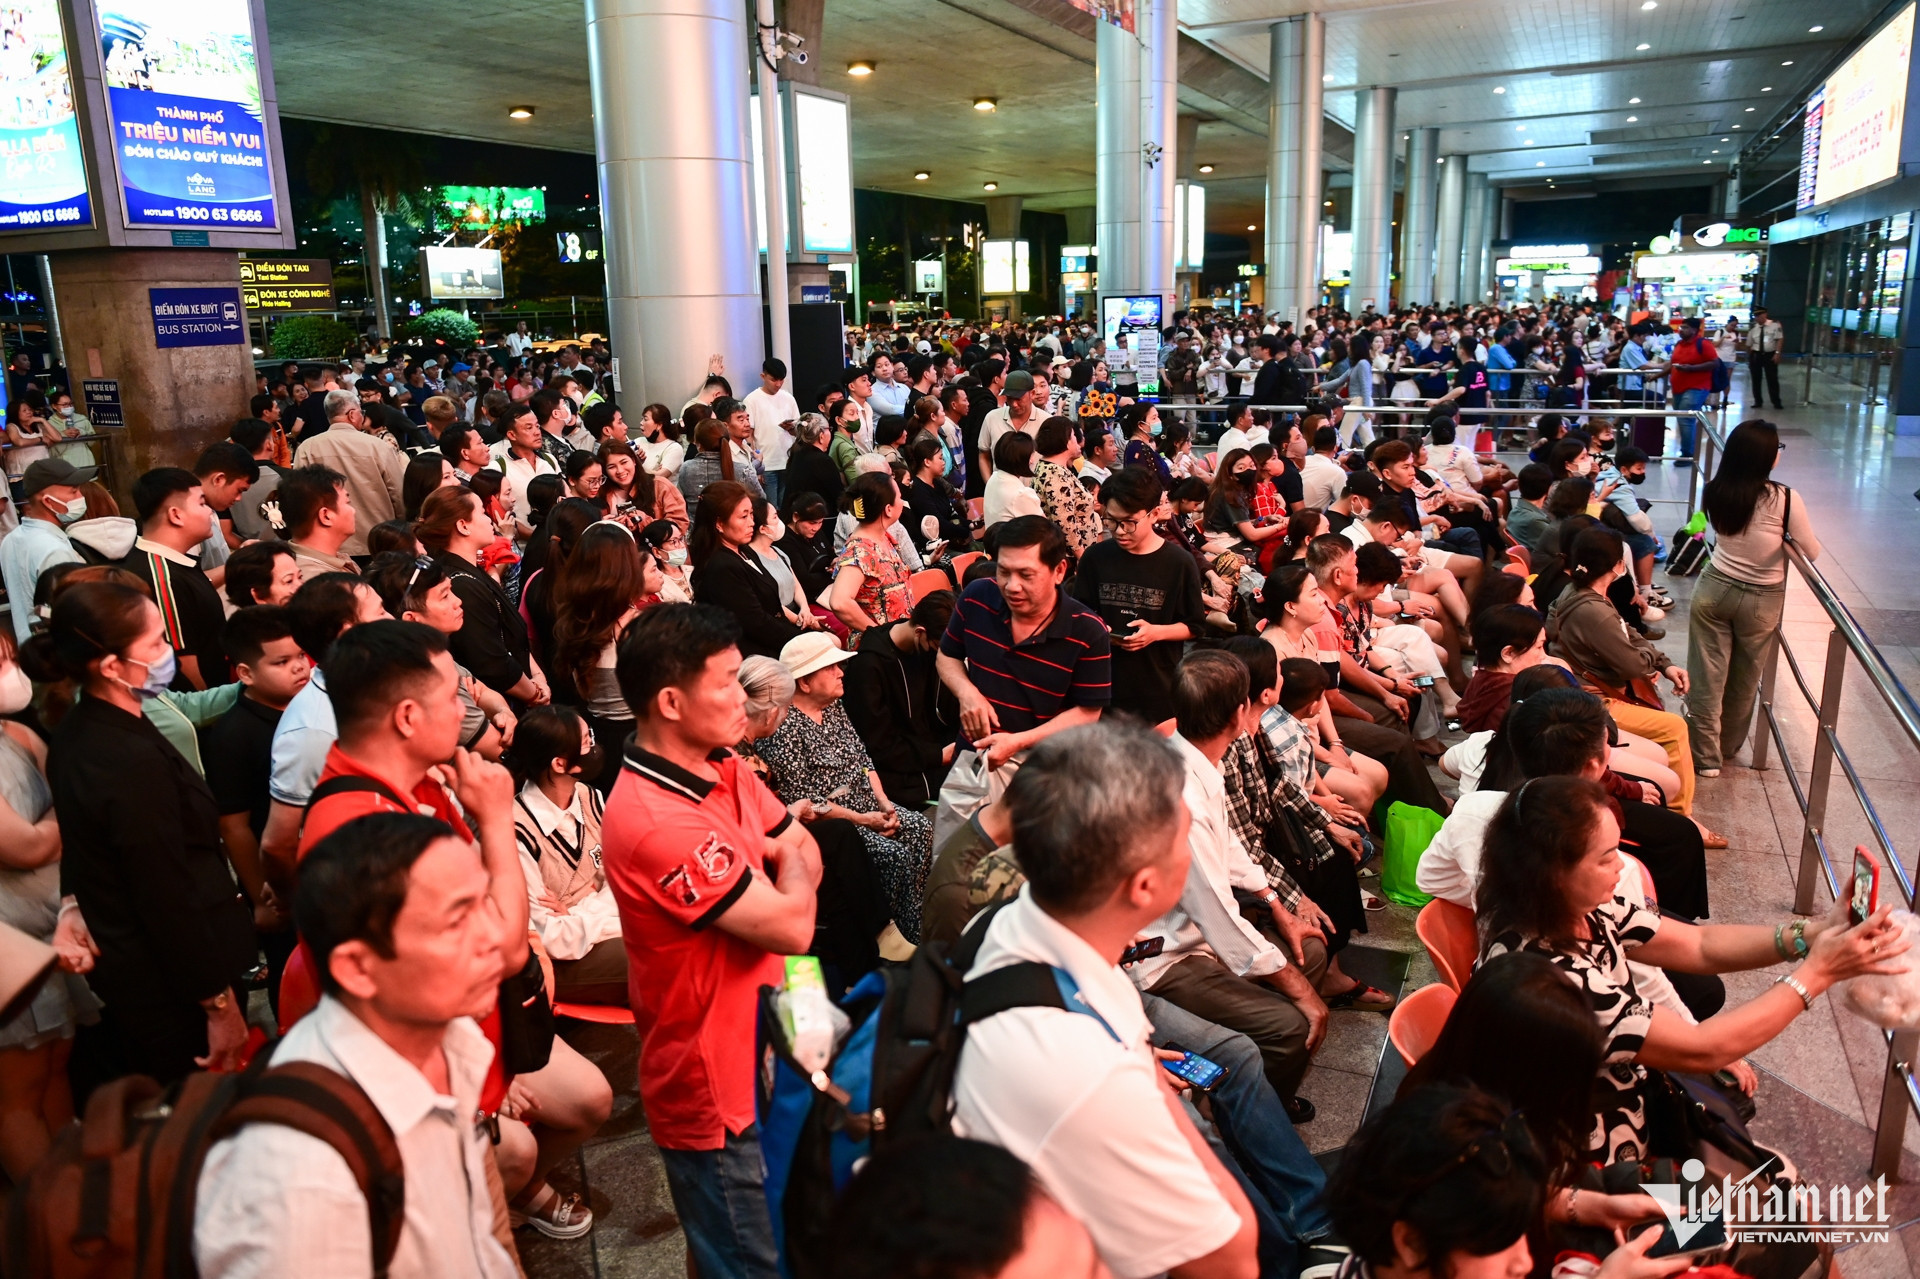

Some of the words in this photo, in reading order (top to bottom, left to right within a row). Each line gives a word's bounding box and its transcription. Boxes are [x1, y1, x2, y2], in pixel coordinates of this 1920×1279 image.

[156, 106, 198, 121] THÀNH
[200, 110, 224, 123] PHỐ
[121, 121, 178, 145] TRIỆU
[182, 124, 227, 146] NIỀM
[230, 132, 261, 149] VUI
[124, 143, 154, 159] ĐÓN
[156, 147, 191, 161] CHÀO
[193, 151, 218, 163] QUÝ
[188, 186, 216, 194] LAND
[18, 210, 41, 224] 1900
[42, 209, 55, 222] 63
[55, 206, 80, 221] 6666
[143, 208, 174, 217] HOTLINE
[175, 206, 209, 220] 1900
[212, 208, 228, 221] 63
[230, 209, 263, 222] 6666
[1726, 227, 1760, 242] BIG
[566, 232, 581, 261] 8
[585, 250, 599, 260] GF
[276, 263, 292, 272] ĐÓN
[293, 264, 309, 272] TAXI
[289, 289, 310, 298] CÔNG
[155, 302, 173, 316] ĐIỂM
[175, 302, 189, 315] ĐÓN
[190, 305, 200, 314] XE
[201, 303, 218, 314] BUÝT
[157, 325, 180, 335] BUS
[181, 323, 222, 334] STATION
[657, 830, 736, 907] 75
